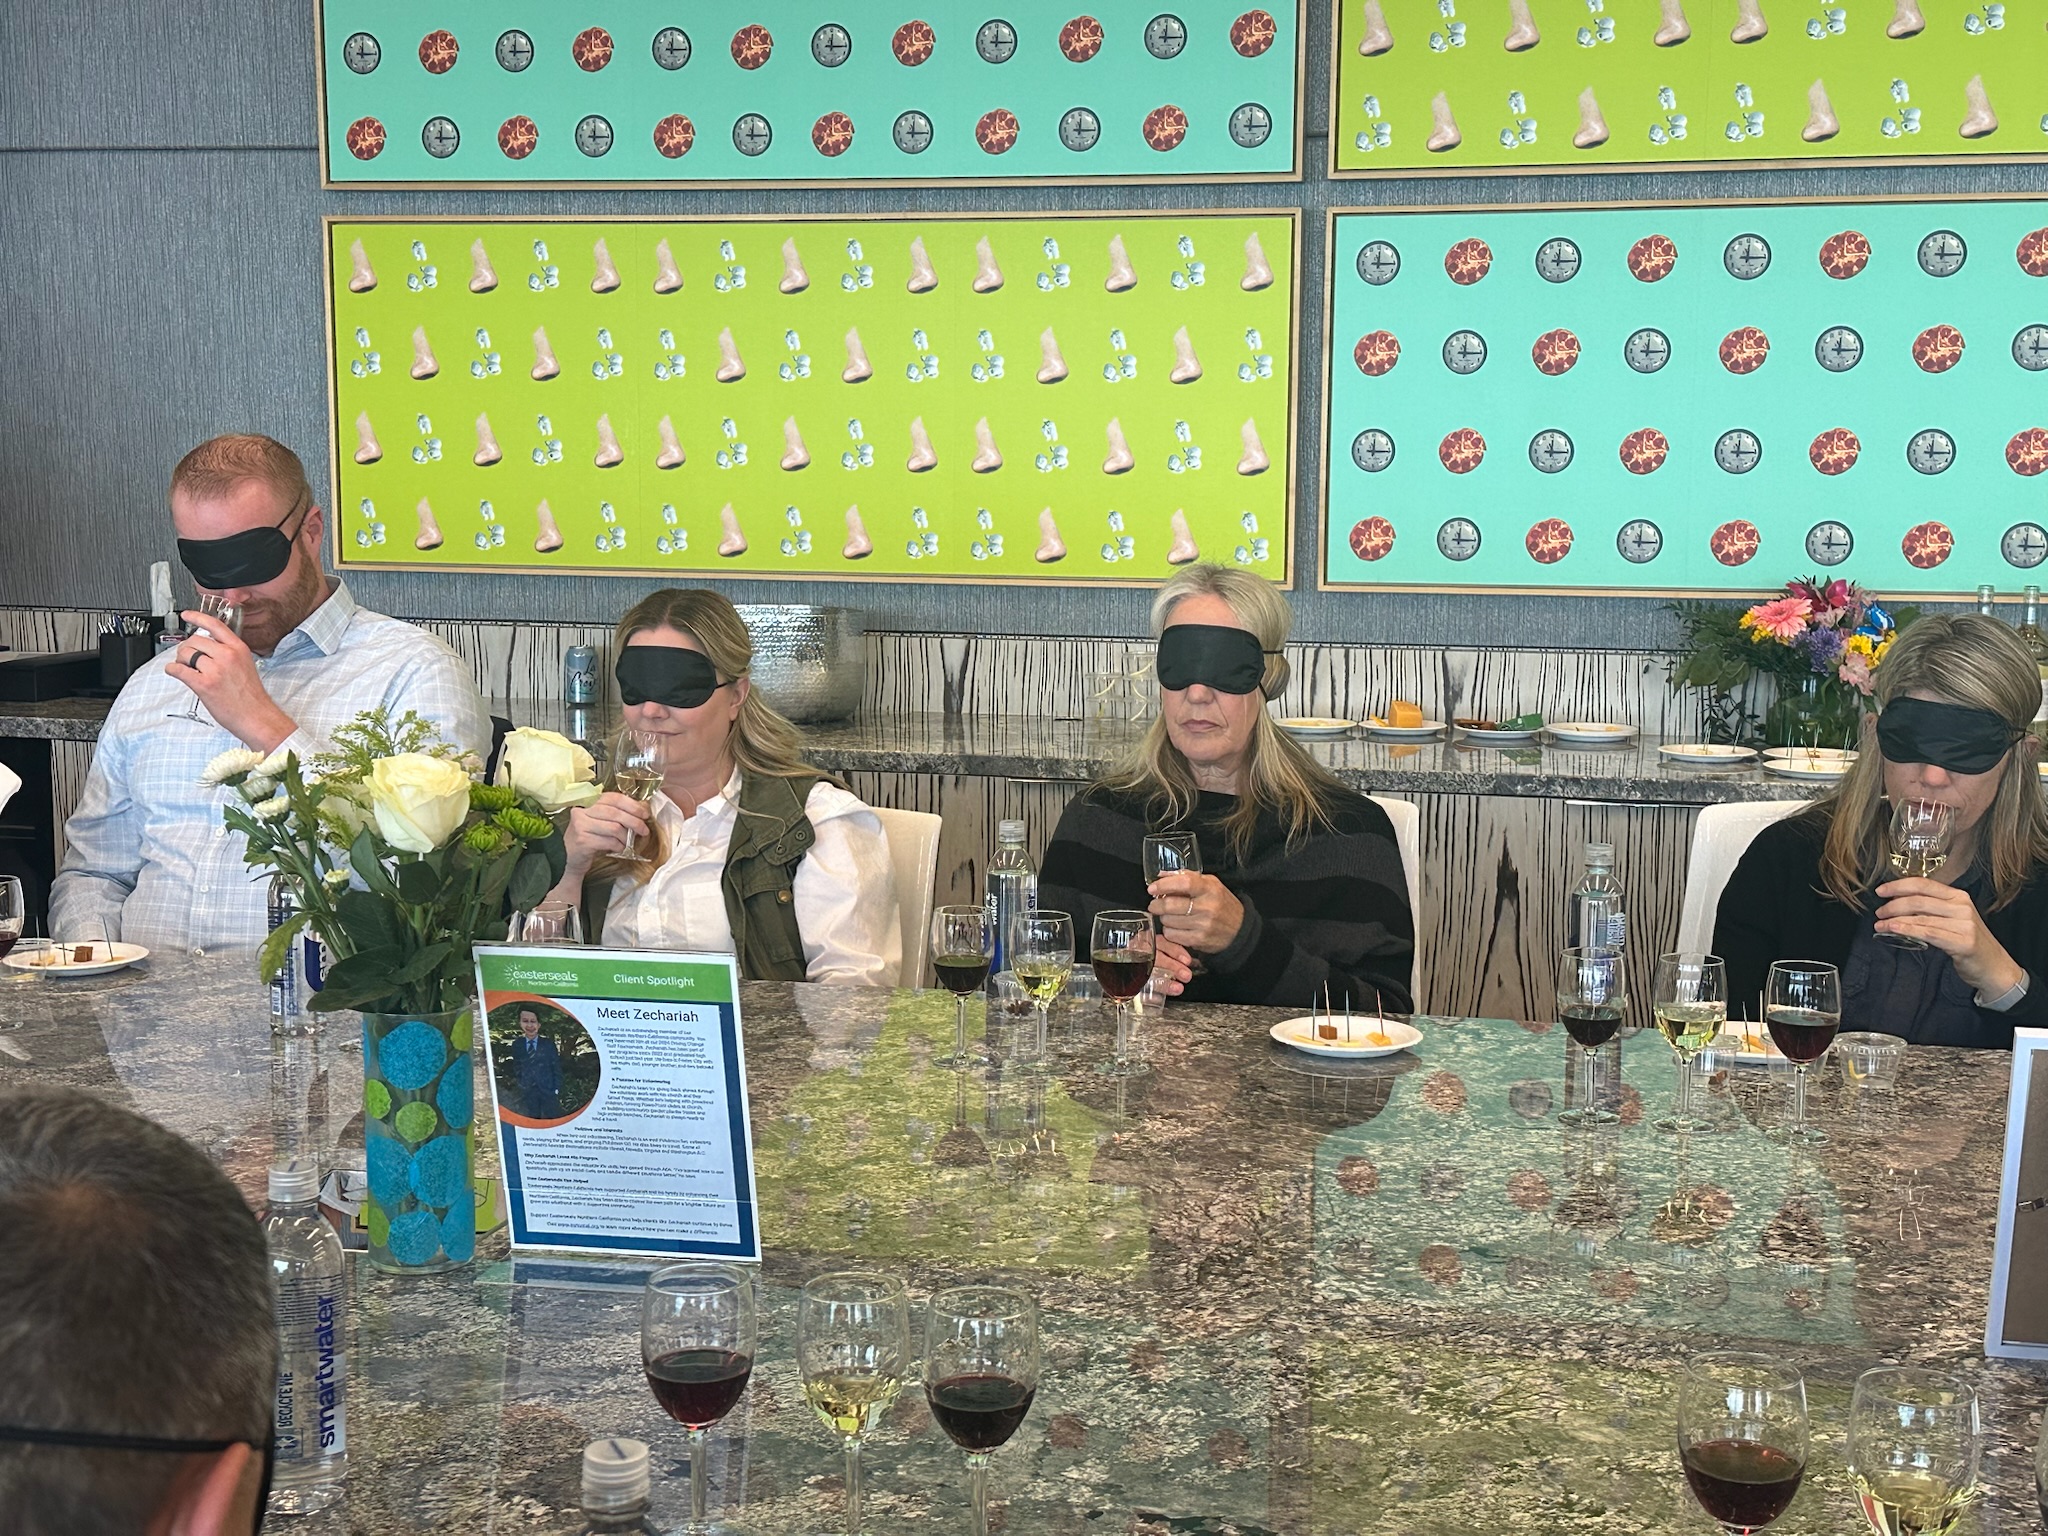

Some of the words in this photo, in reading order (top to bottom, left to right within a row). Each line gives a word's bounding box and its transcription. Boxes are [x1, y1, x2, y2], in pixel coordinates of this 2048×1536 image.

[513, 970, 578, 981] easterseals
[613, 974, 644, 984] Client
[647, 975, 695, 988] Spotlight
[597, 1007, 630, 1019] Meet
[633, 1008, 699, 1022] Zechariah
[314, 1295, 336, 1448] smartwater
